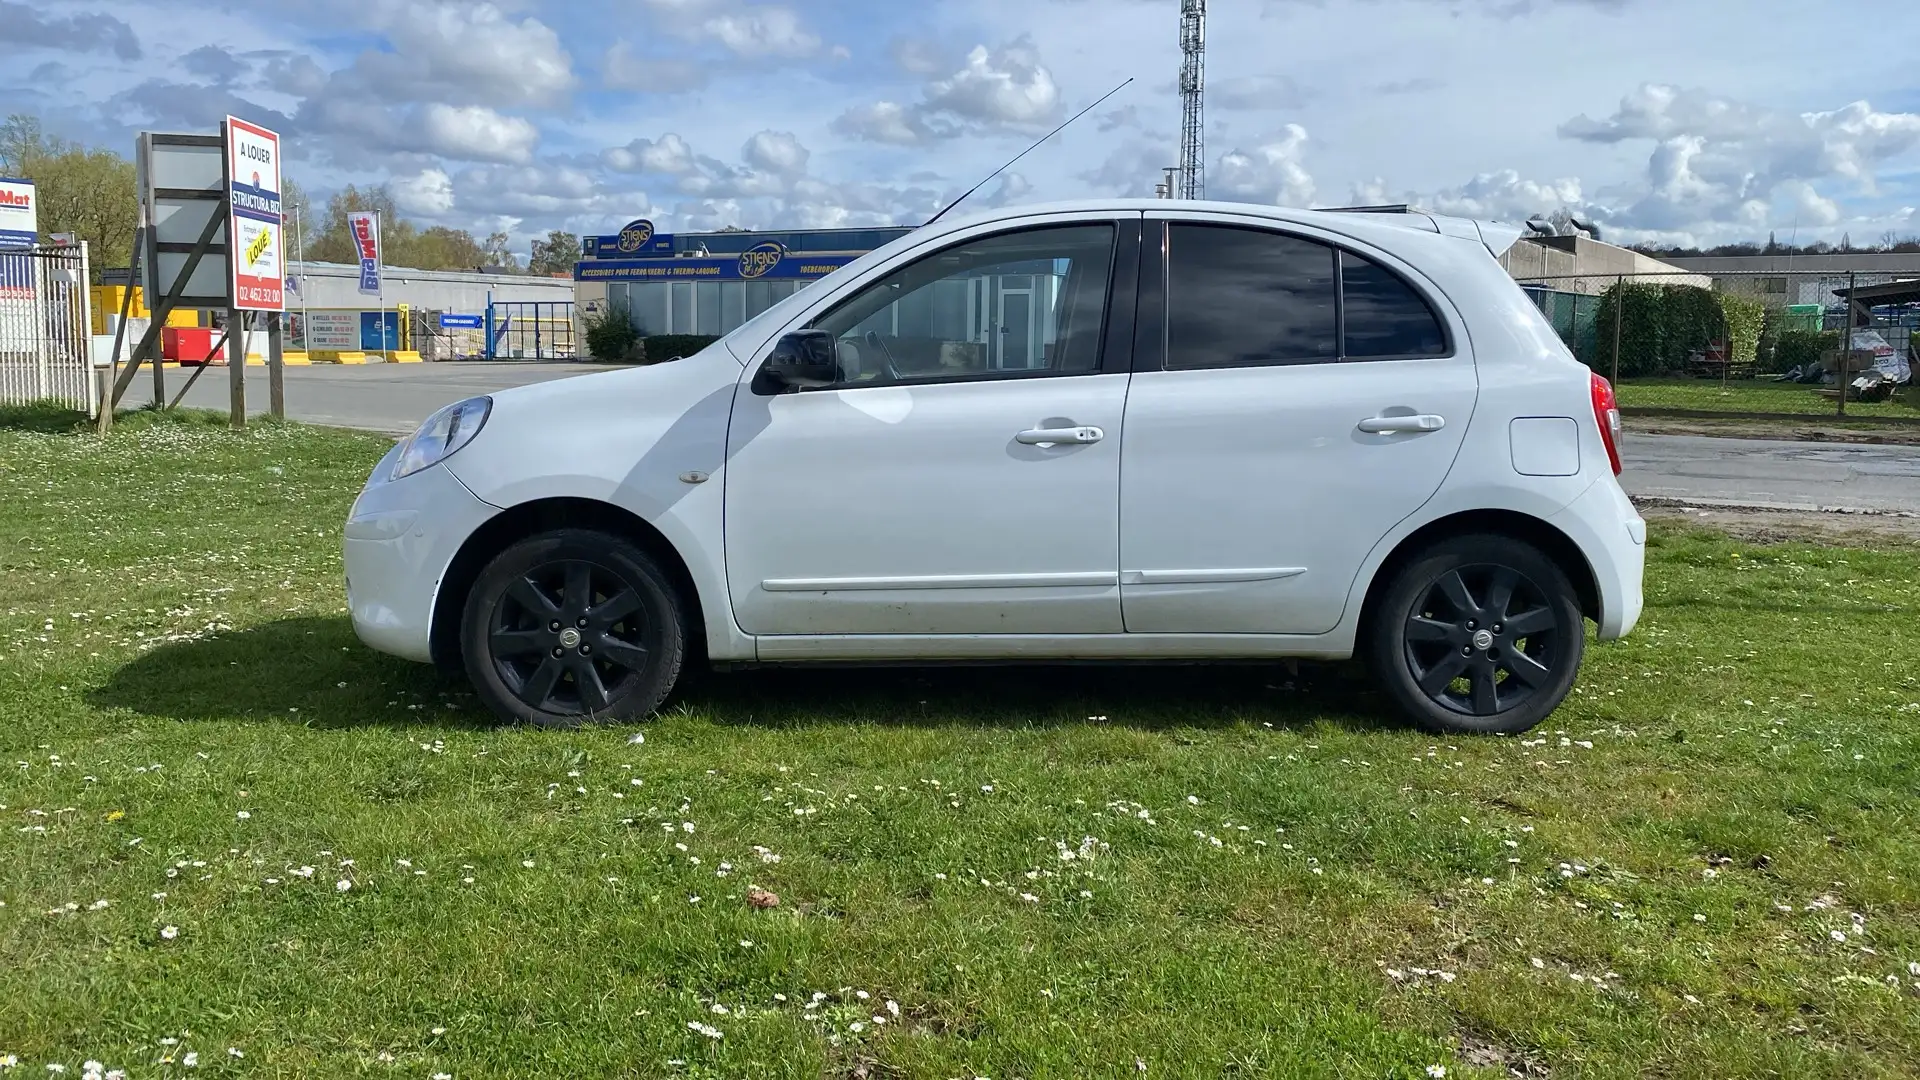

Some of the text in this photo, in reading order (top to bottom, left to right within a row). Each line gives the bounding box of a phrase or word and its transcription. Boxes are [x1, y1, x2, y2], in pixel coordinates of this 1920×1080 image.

[241, 142, 271, 164] A LOUER
[621, 230, 651, 241] STIENS
[742, 251, 778, 265] STIENS
[581, 269, 615, 277] ACCESSOIRES
[615, 268, 630, 276] POUR
[239, 286, 281, 304] 02 462 32 00
